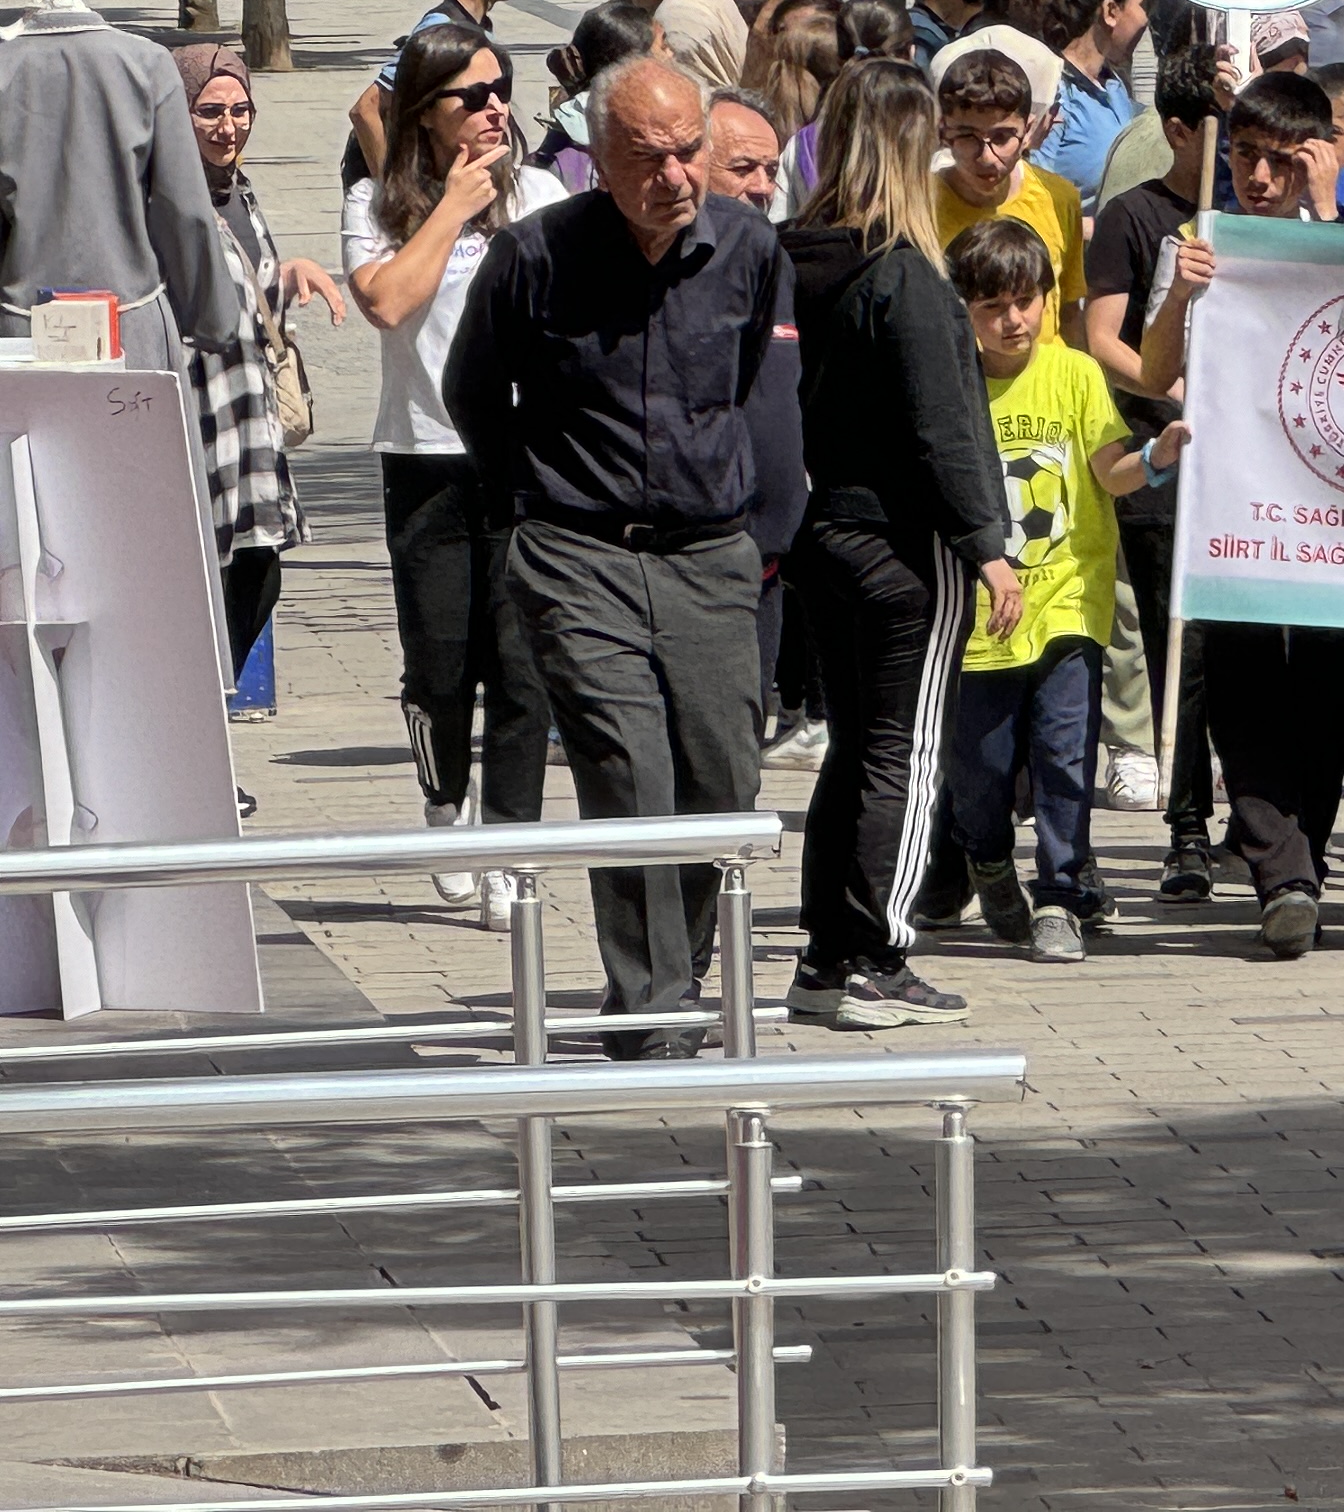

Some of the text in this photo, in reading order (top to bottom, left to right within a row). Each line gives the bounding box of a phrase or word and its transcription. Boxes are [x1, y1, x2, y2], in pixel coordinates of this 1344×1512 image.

[1250, 501, 1286, 522] T.C.
[1209, 533, 1265, 561] SİİRT
[1270, 535, 1291, 562] İL
